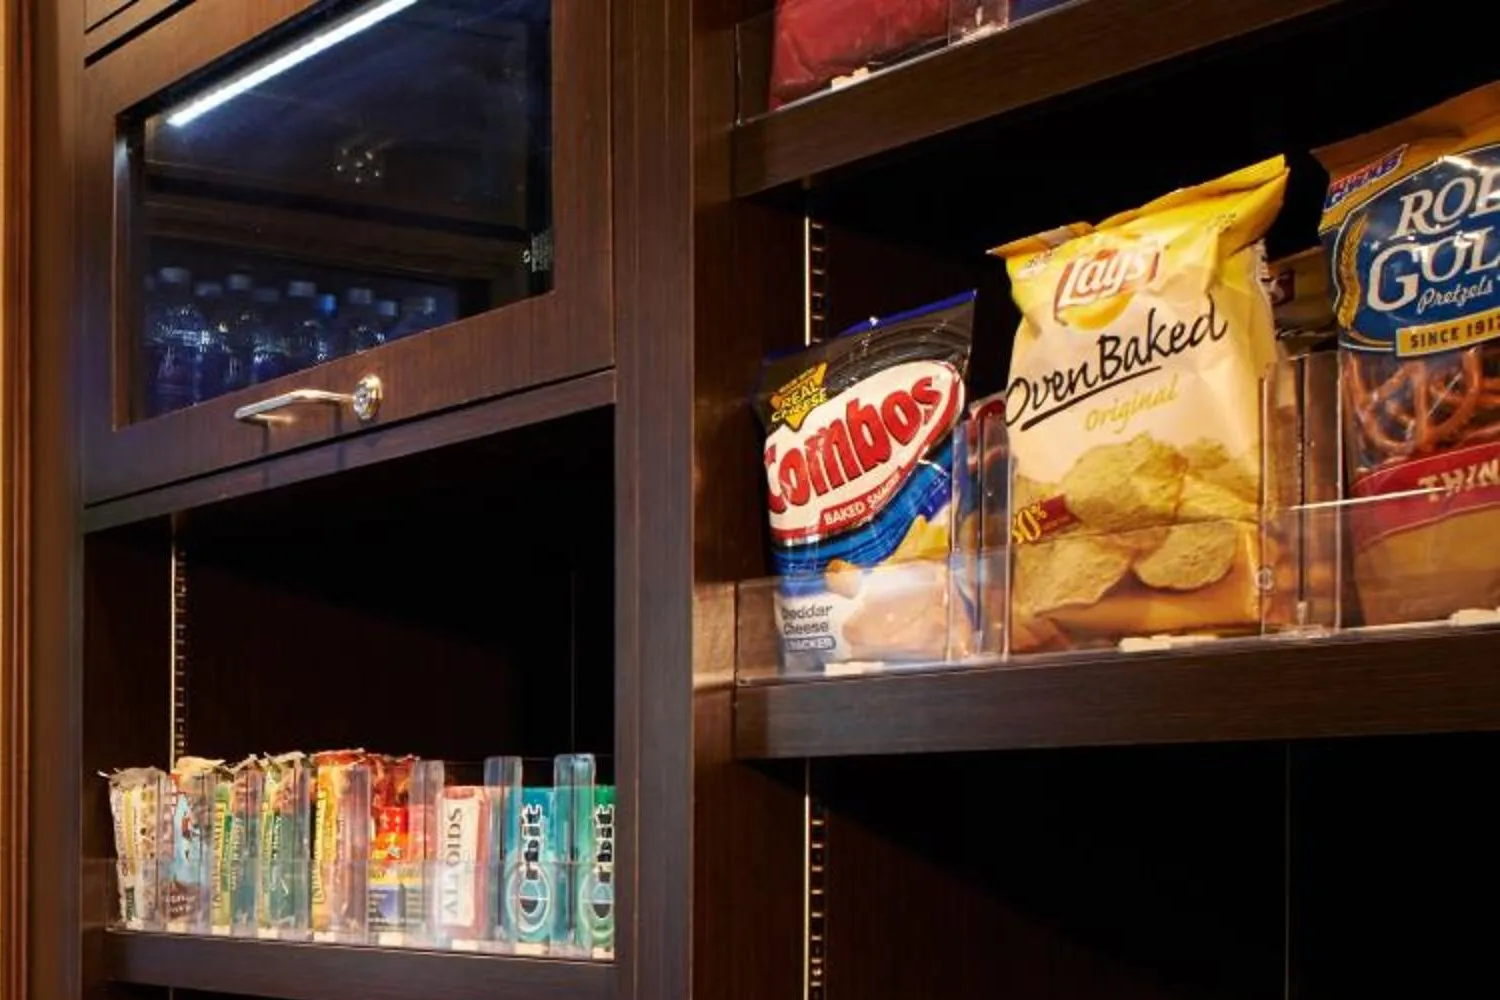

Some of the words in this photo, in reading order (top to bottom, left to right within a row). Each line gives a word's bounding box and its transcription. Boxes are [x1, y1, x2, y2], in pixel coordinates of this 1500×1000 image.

[1416, 275, 1494, 315] Pretzels
[1410, 326, 1459, 347] SINCE
[1003, 361, 1100, 428] Oven
[1097, 294, 1229, 381] Baked
[823, 501, 865, 524] BAKED
